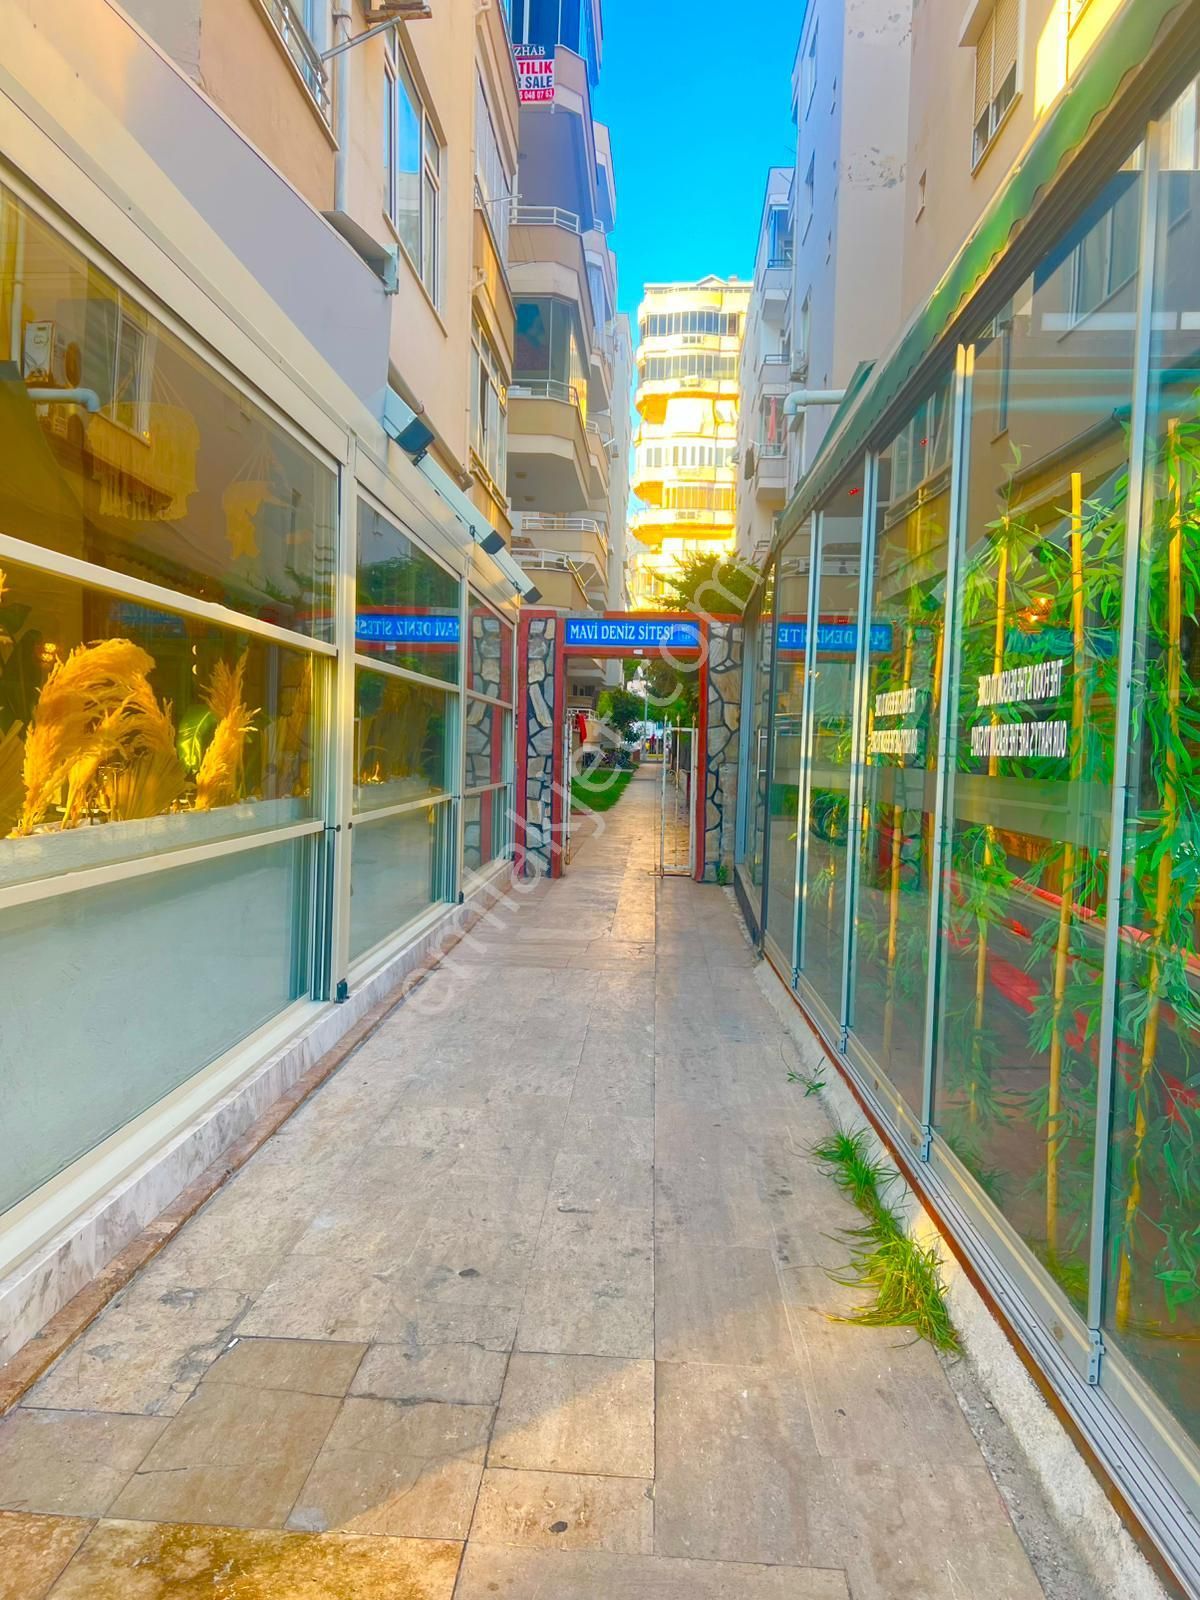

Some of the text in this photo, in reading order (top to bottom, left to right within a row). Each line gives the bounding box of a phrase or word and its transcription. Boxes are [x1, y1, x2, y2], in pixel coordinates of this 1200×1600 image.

[525, 76, 553, 89] SALE
[570, 622, 598, 640] MAVİ
[601, 623, 635, 640] DENİZ
[638, 623, 674, 641] SİTESİ
